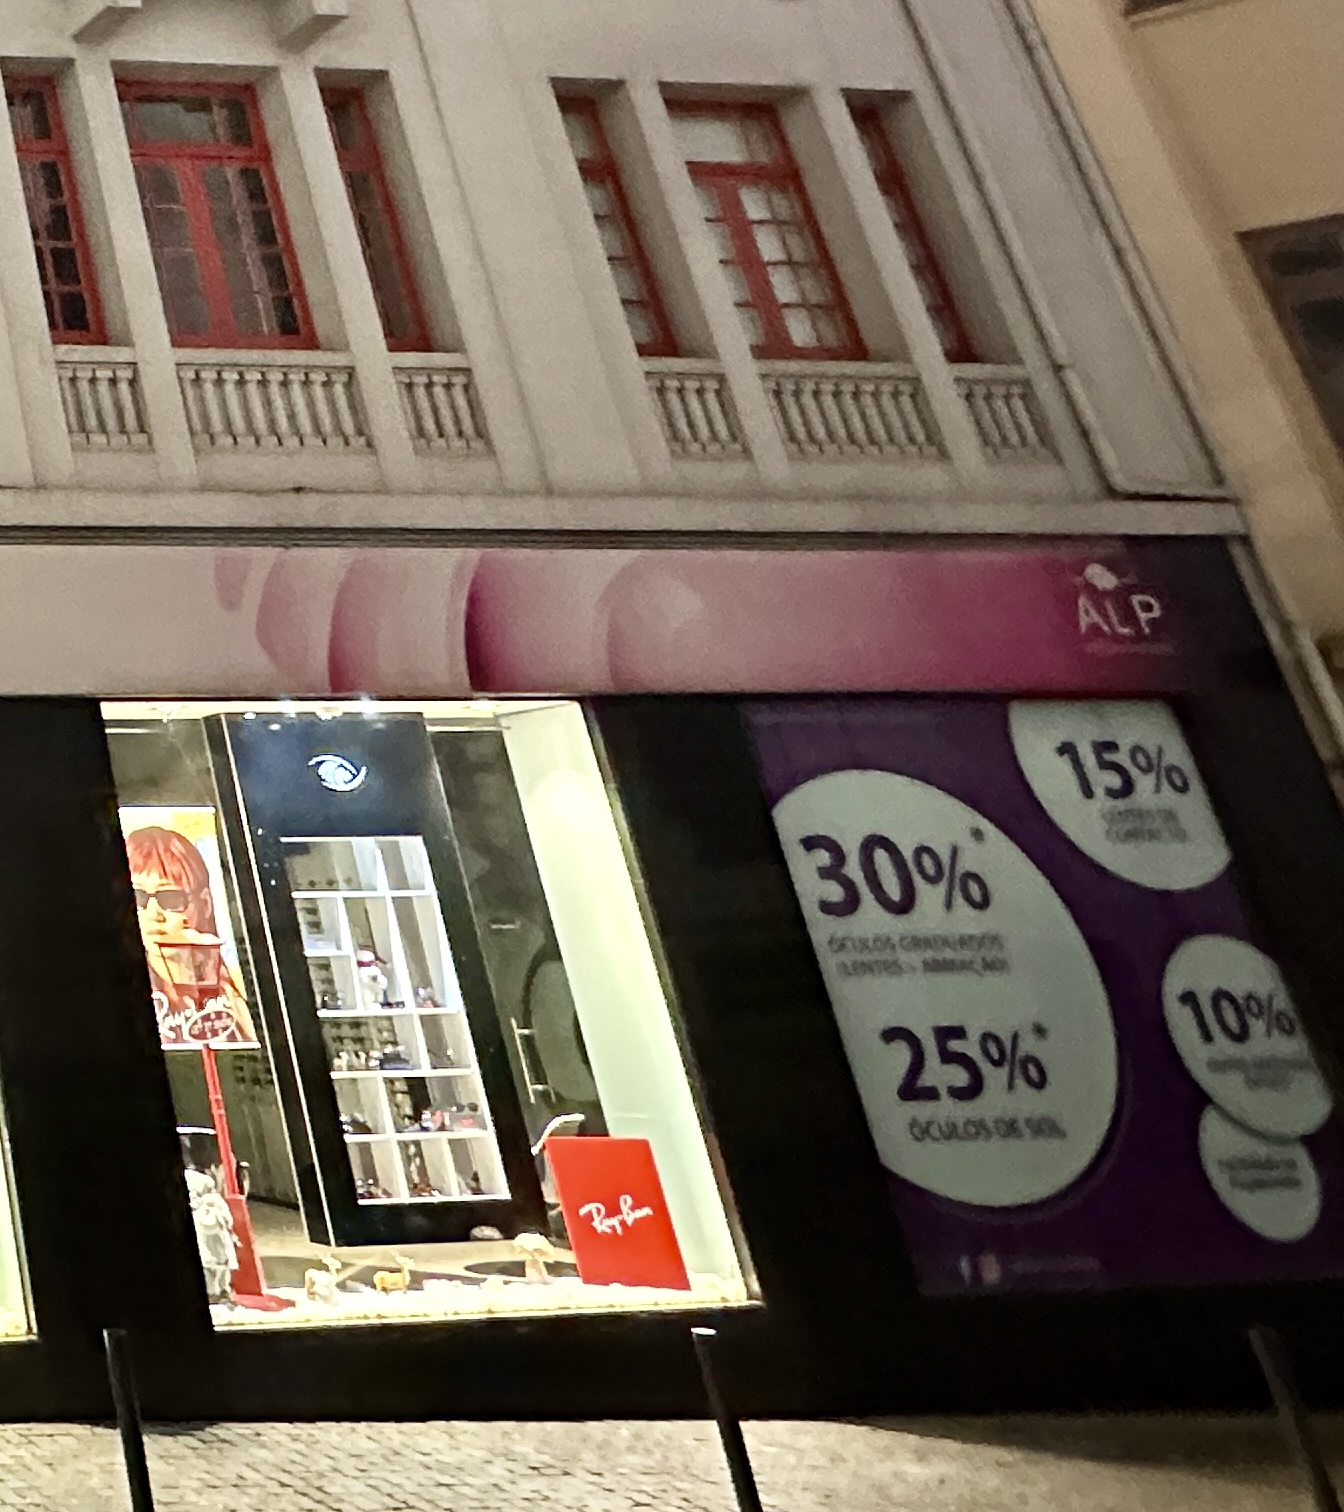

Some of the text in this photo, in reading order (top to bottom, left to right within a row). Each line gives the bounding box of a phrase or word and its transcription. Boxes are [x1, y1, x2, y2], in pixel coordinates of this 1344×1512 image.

[1078, 593, 1162, 635] ALP
[1055, 740, 1190, 800] 15%
[1178, 989, 1296, 1045] 10%
[578, 1194, 654, 1236] Ray-Ban
